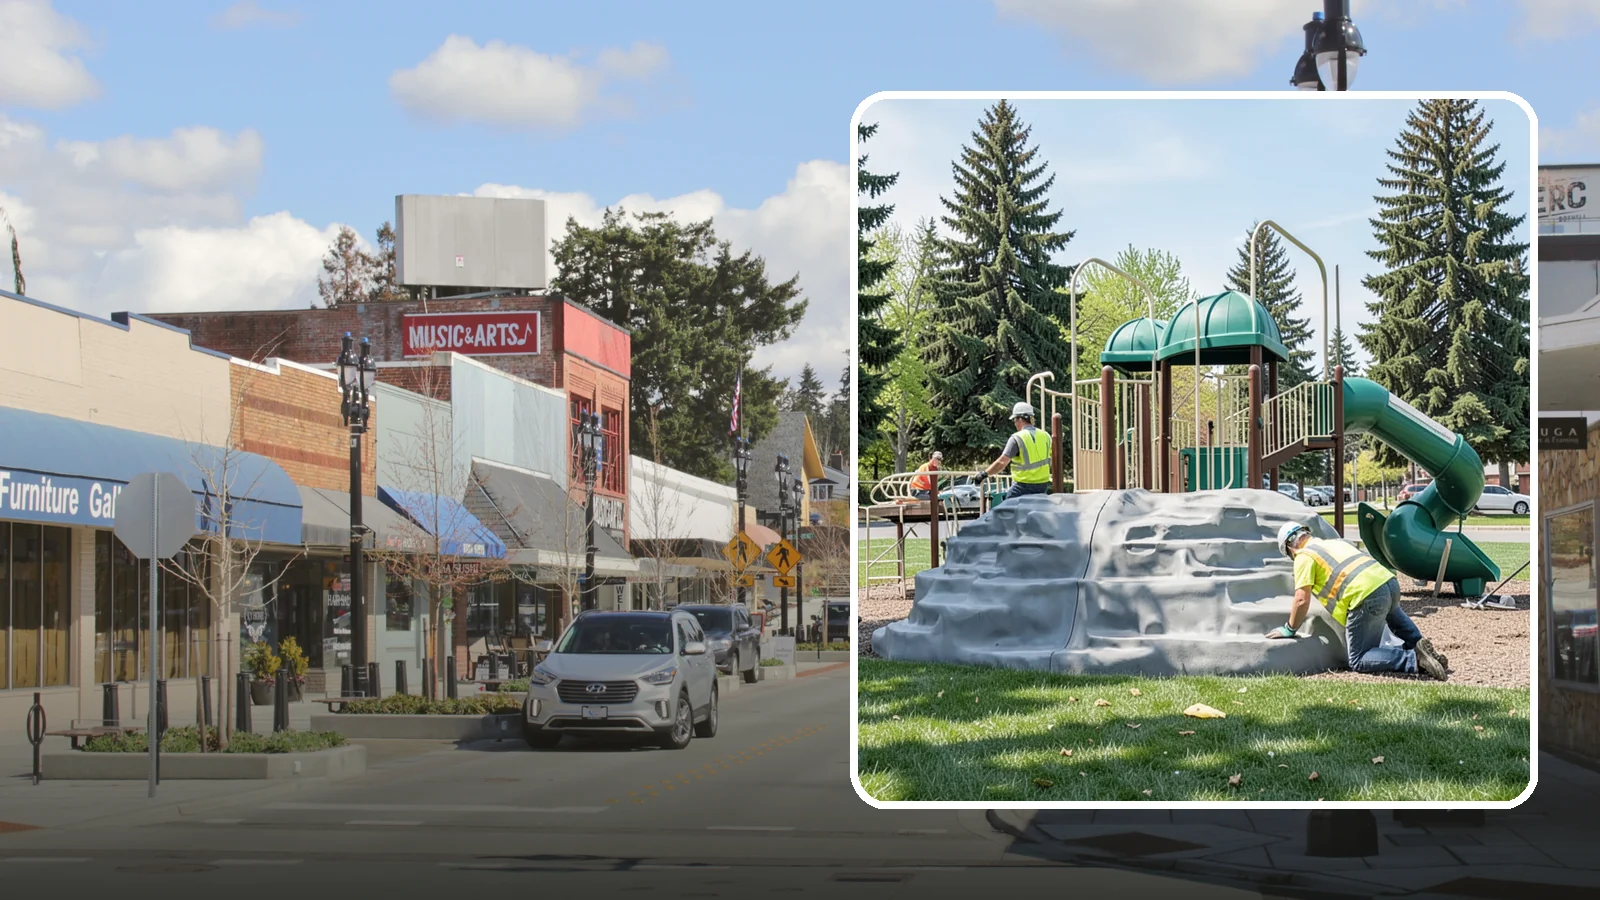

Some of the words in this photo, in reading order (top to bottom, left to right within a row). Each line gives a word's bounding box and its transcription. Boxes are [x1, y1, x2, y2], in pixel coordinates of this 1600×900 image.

[409, 323, 519, 349] MUSIC&ARTS
[0, 471, 79, 515] Furniture
[89, 482, 122, 519] Gal
[453, 562, 480, 574] SUSHI
